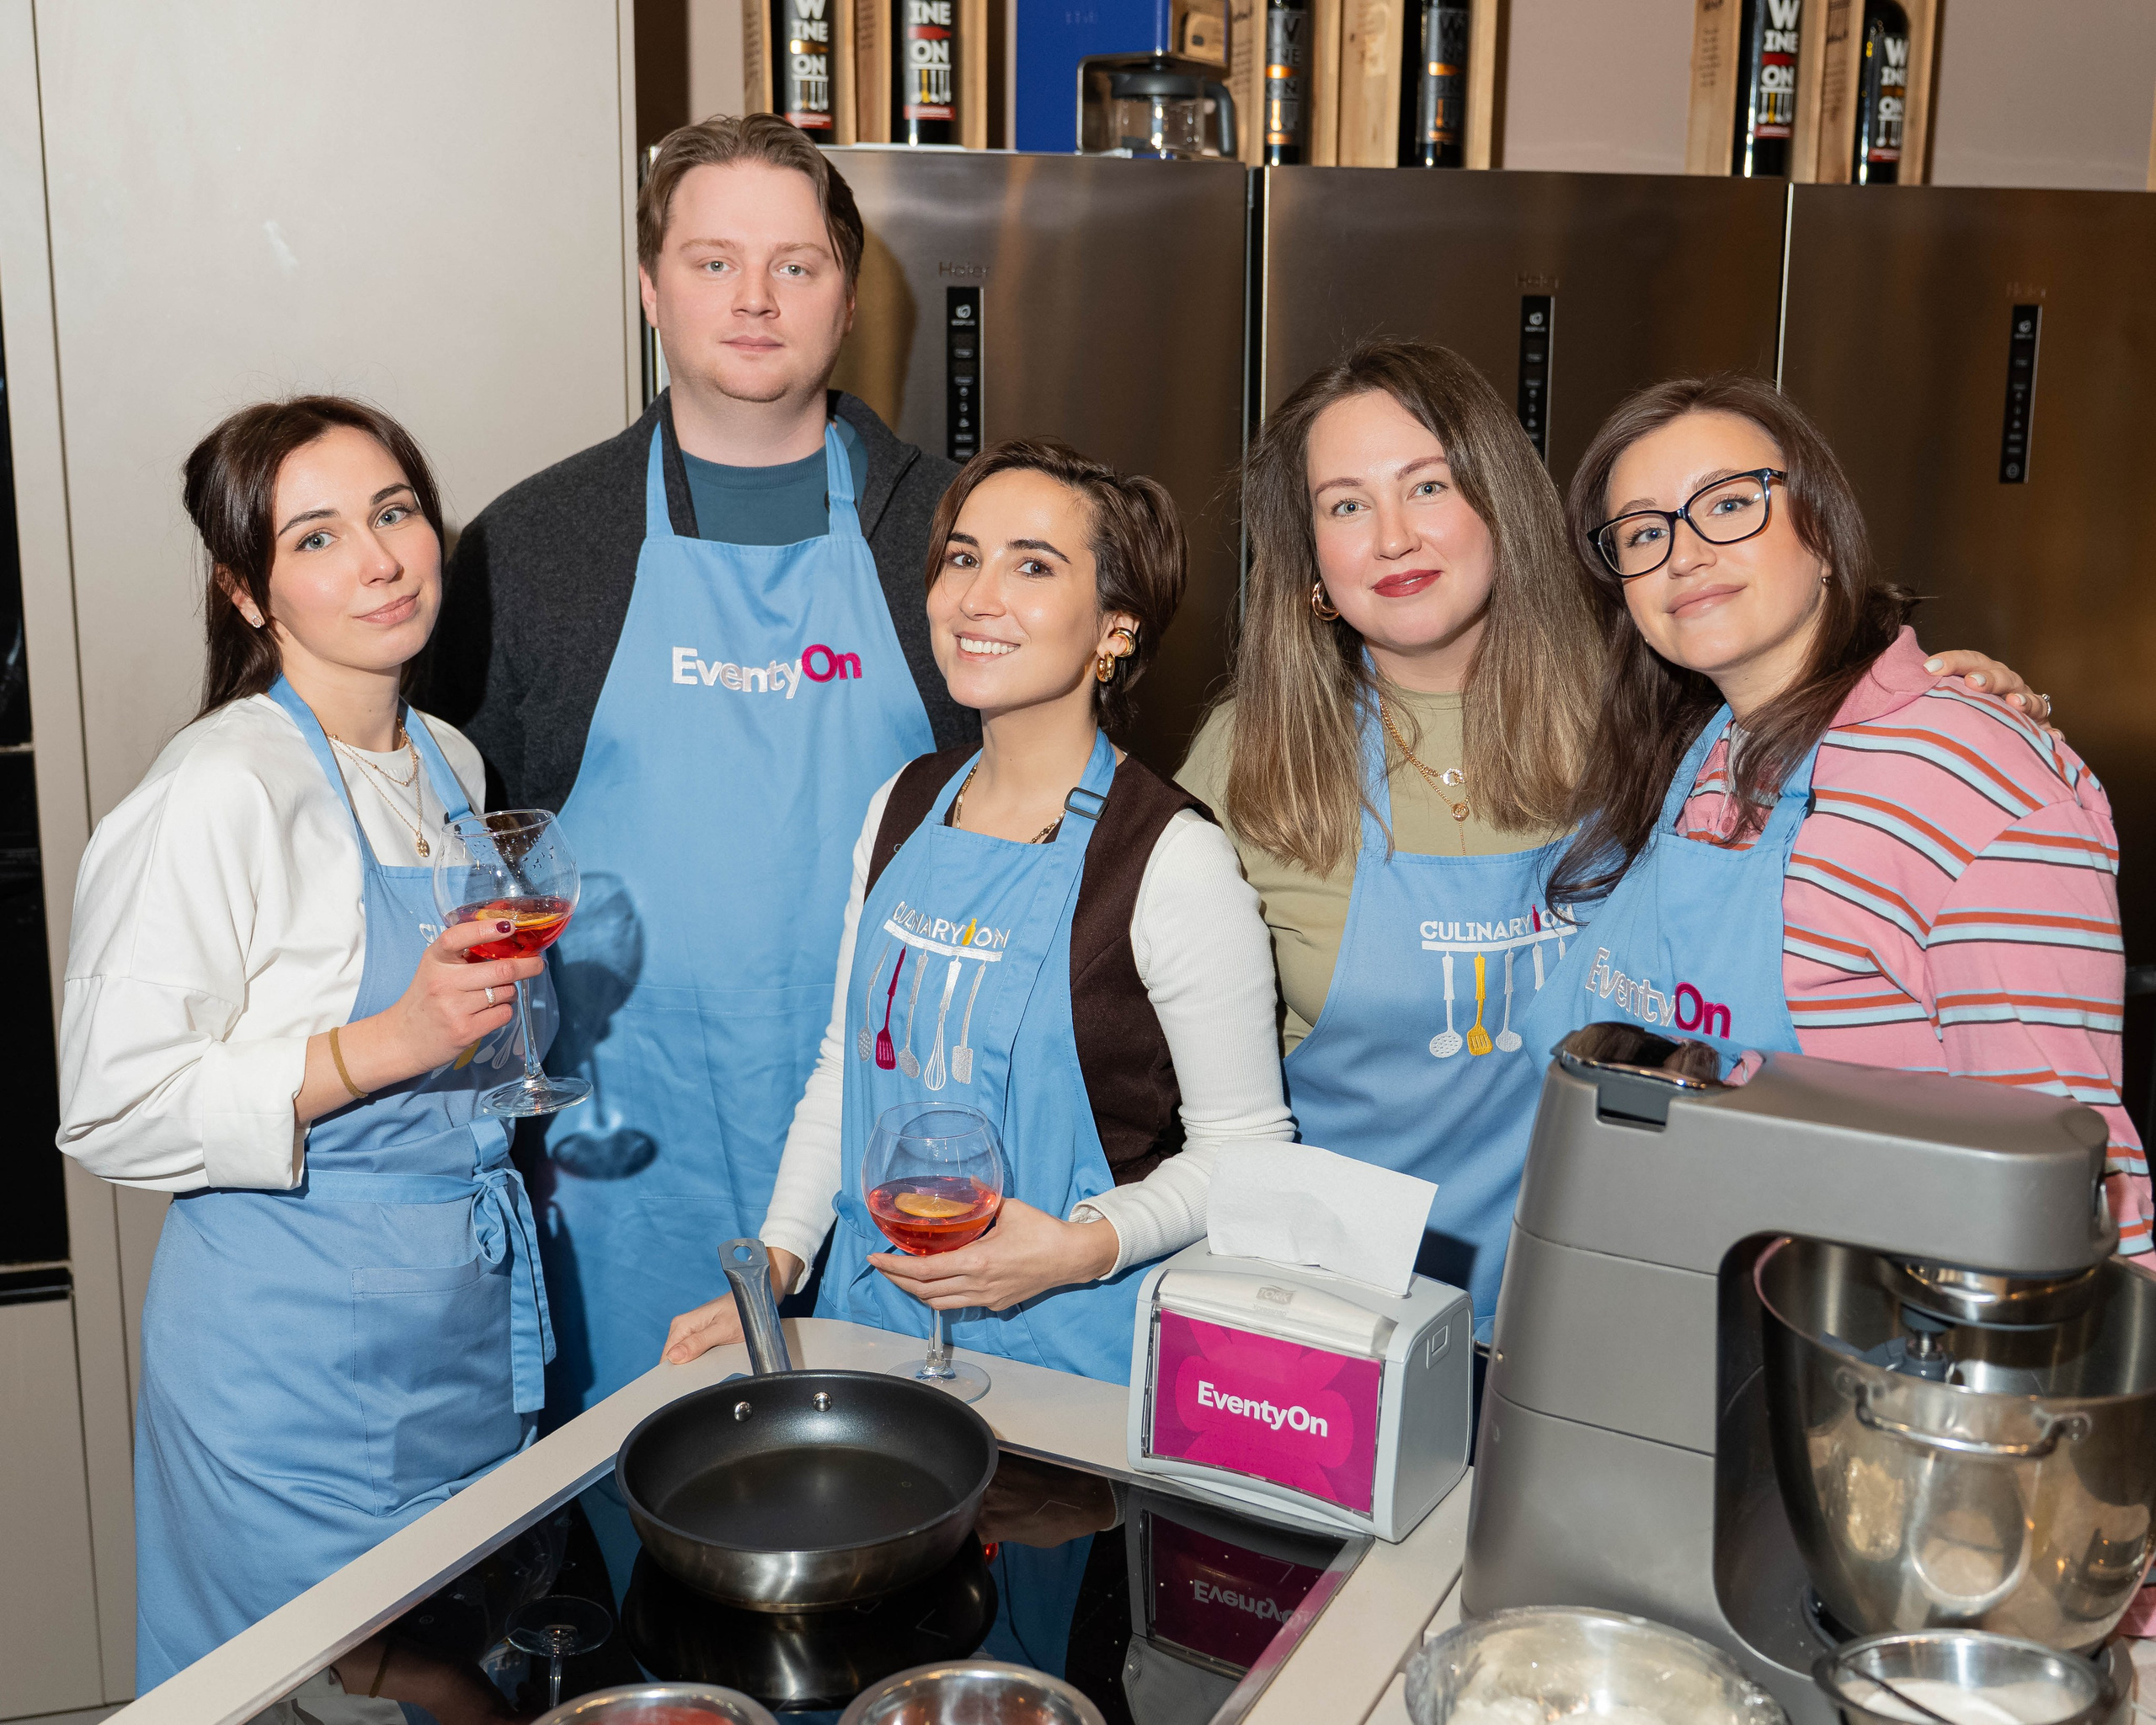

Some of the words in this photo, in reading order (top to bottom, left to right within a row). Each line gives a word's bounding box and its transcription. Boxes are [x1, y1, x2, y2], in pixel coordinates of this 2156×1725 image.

[909, 1, 952, 25] INE
[1769, 0, 1801, 30] W
[791, 20, 829, 42] INE
[1764, 29, 1799, 53] INE
[910, 40, 950, 64] ON
[1884, 37, 1910, 67] W
[791, 55, 827, 76] ON
[1761, 64, 1796, 88] ON
[672, 644, 863, 699] EventyOn
[974, 927, 1011, 948] ON
[1419, 914, 1531, 942] CULINARY
[1585, 947, 1732, 1039] EventyOn
[1259, 1287, 1292, 1303] TORK
[1198, 1380, 1328, 1437] EventyOn
